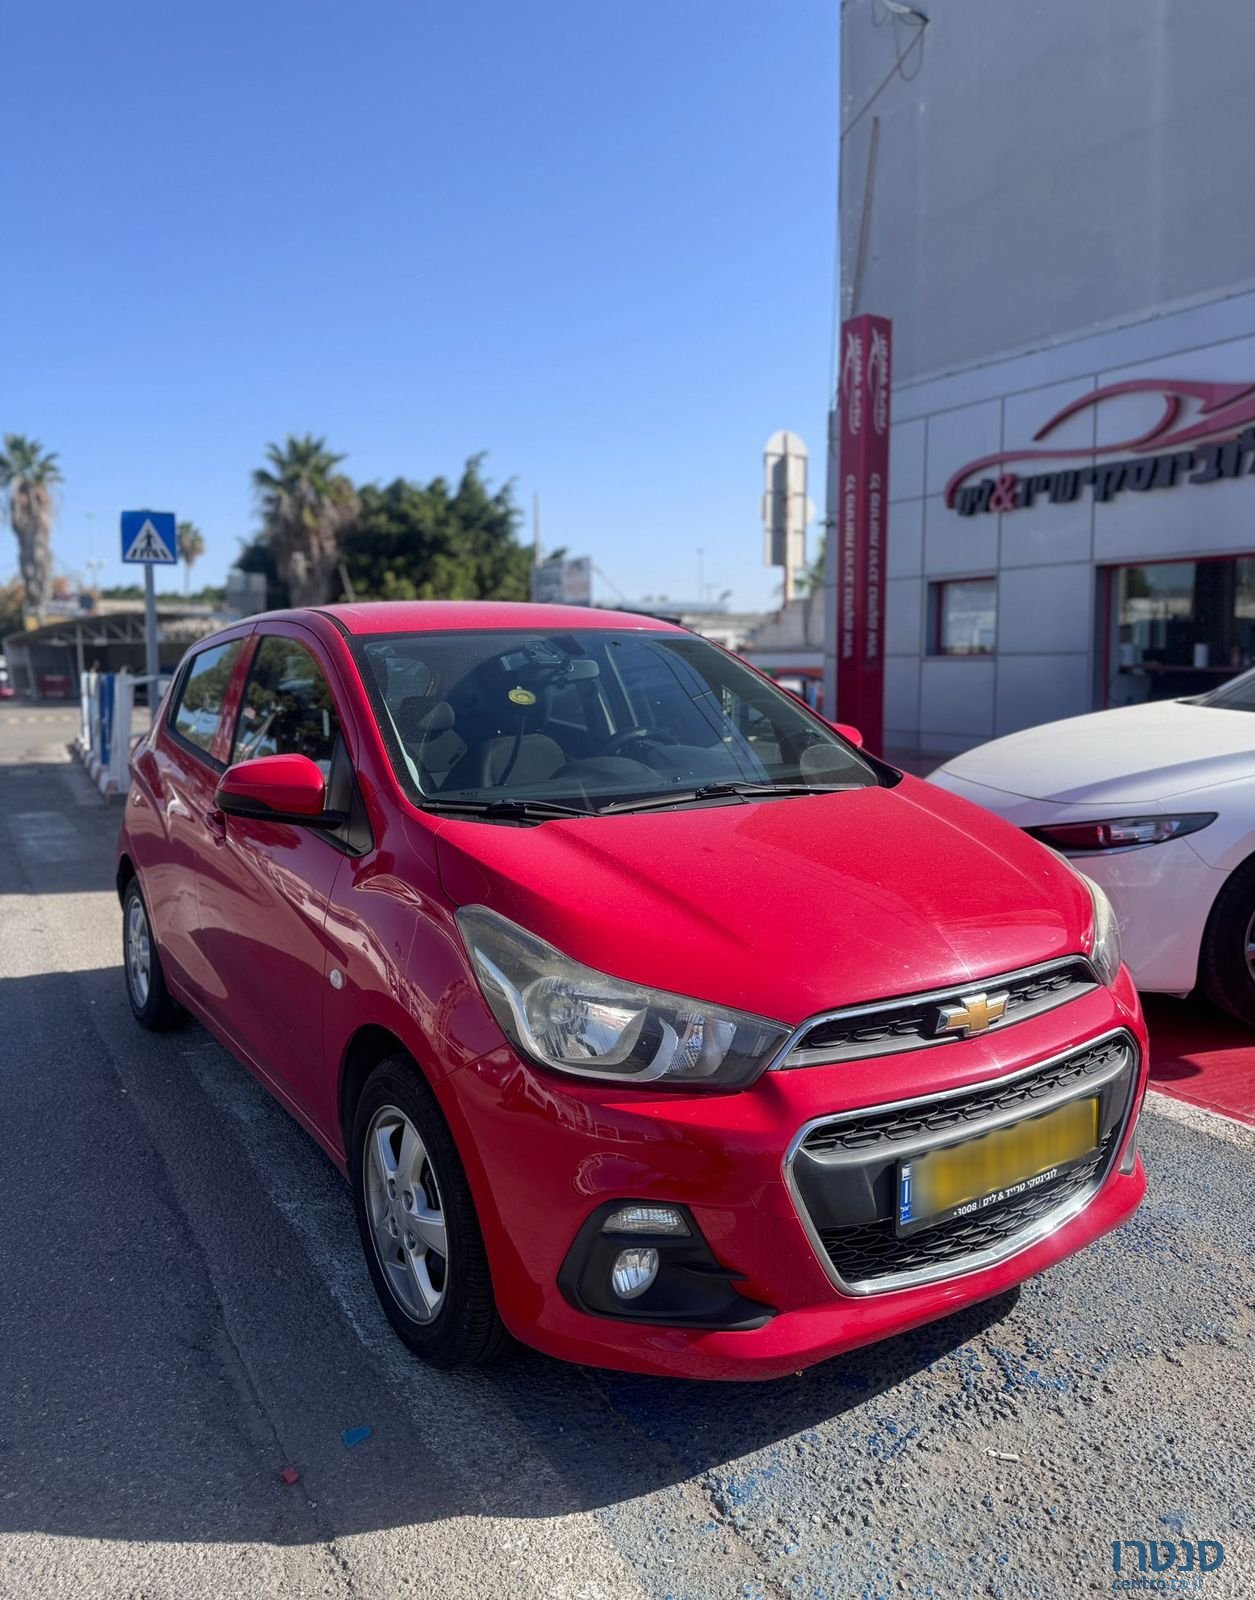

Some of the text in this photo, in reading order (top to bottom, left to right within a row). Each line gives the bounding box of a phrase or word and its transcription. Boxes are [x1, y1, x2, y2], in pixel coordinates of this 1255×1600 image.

[990, 474, 1018, 513] &
[1026, 1167, 1058, 1189] לובינסקי
[997, 1191, 1005, 1201] &
[1004, 1181, 1026, 1198] טרייד
[982, 1193, 998, 1207] ליס
